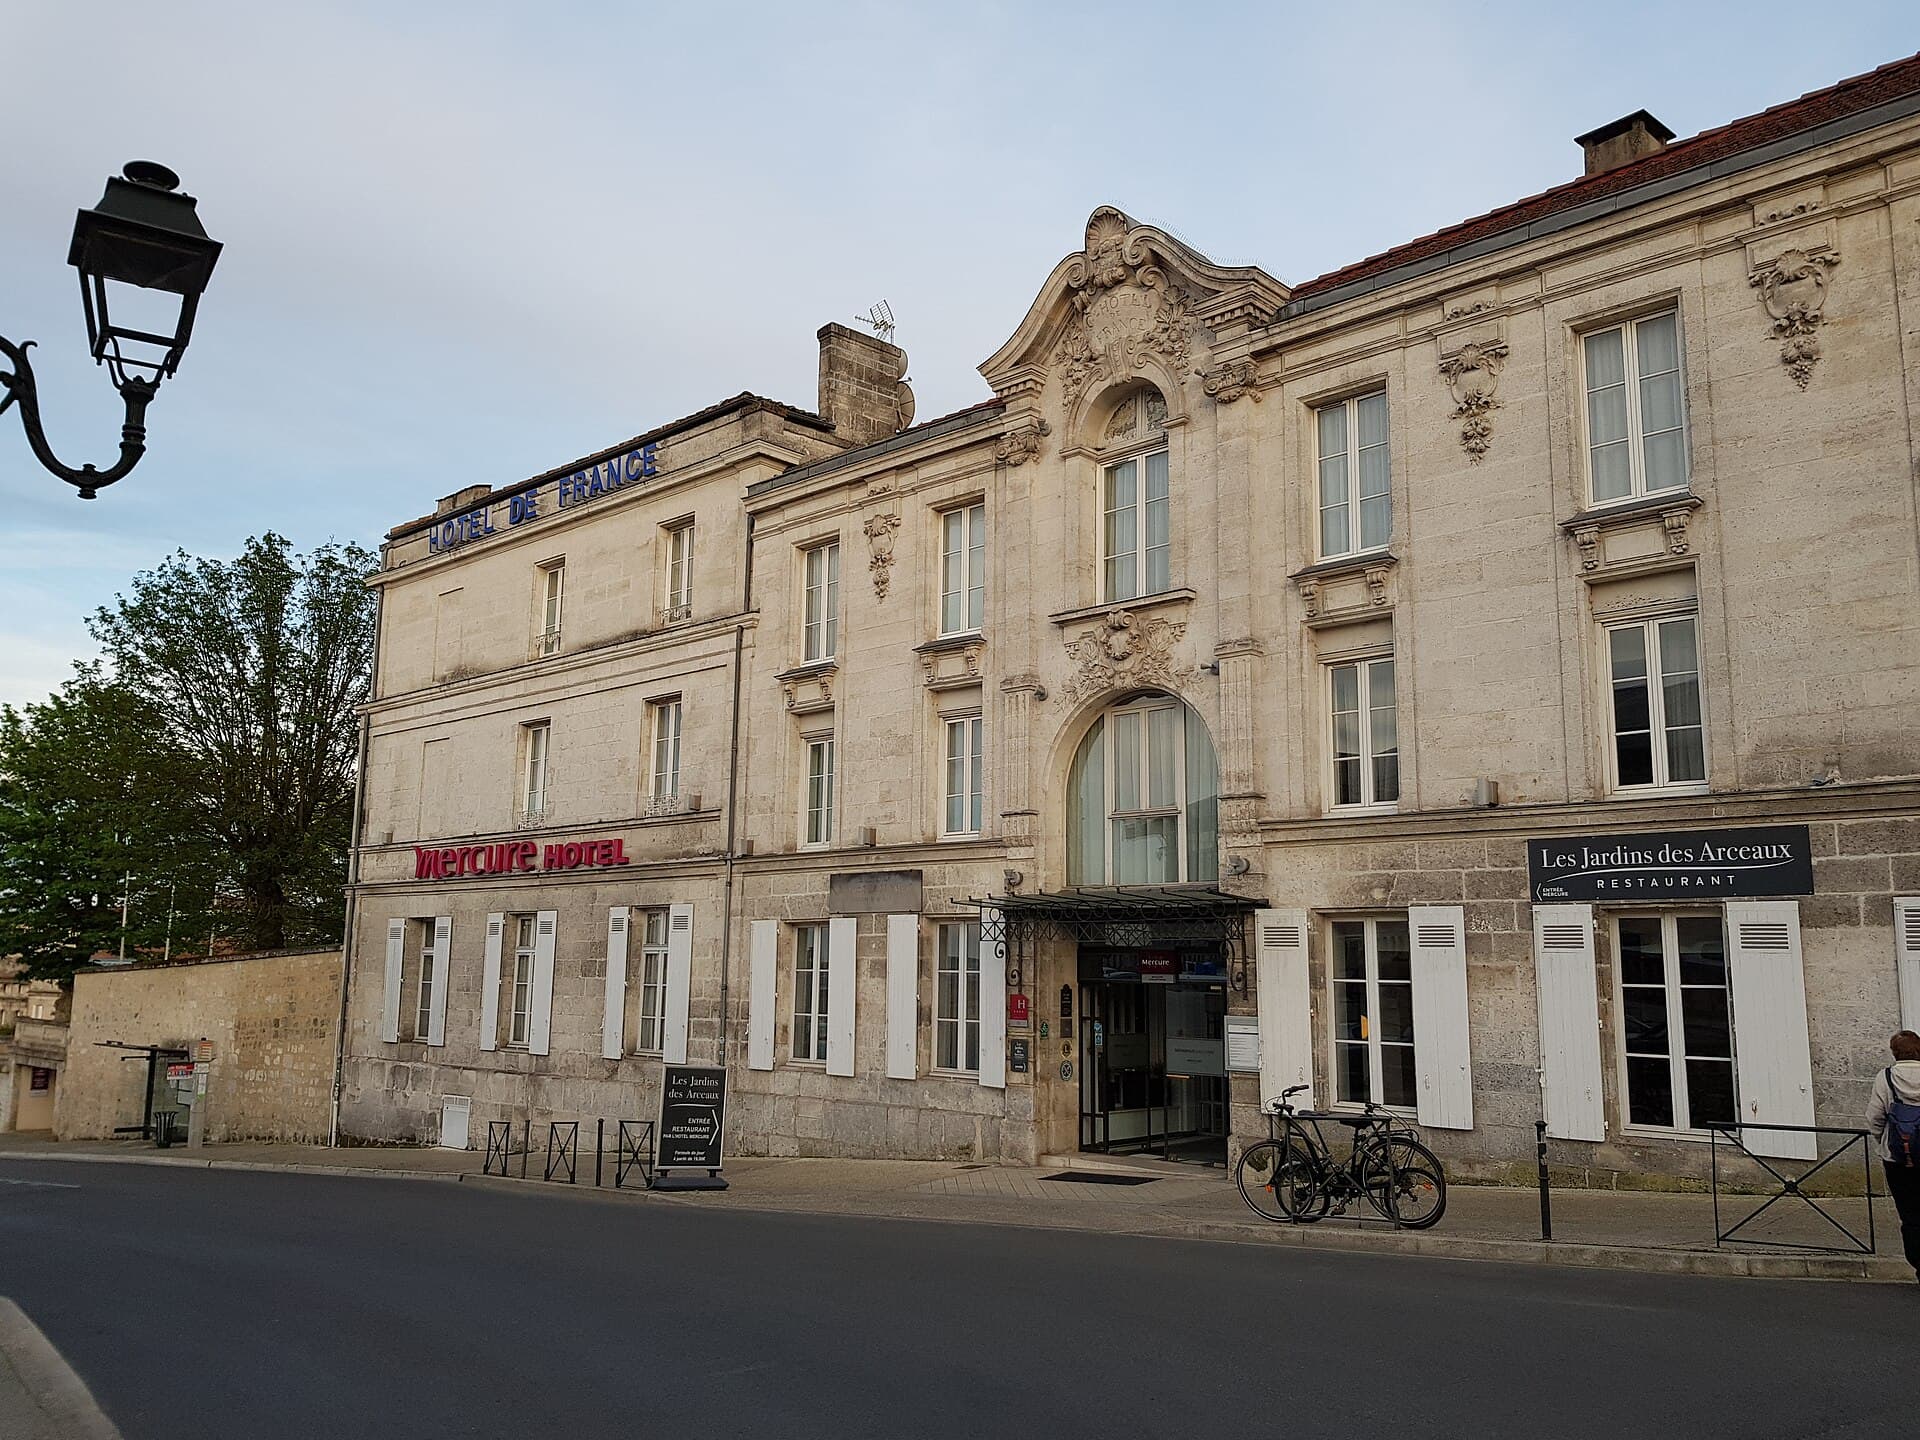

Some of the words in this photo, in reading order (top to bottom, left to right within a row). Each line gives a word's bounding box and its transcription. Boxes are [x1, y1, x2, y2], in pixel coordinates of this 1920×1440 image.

[1099, 293, 1152, 314] HOTEL
[1096, 317, 1146, 340] FRANCE
[428, 508, 494, 552] HOTEL
[509, 490, 538, 525] DE
[559, 443, 658, 507] FRANCE
[544, 839, 629, 869] HOTEL
[1541, 848, 1577, 868] Les
[1580, 846, 1654, 870] Jardins
[1658, 843, 1694, 864] des
[1696, 841, 1793, 862] Arceaux
[1597, 875, 1737, 889] RESTAURANT
[1017, 999, 1025, 1009] H
[672, 1075, 688, 1086] Les
[690, 1075, 719, 1087] Jardins
[668, 1088, 683, 1098] des
[686, 1089, 720, 1099] Arceaux
